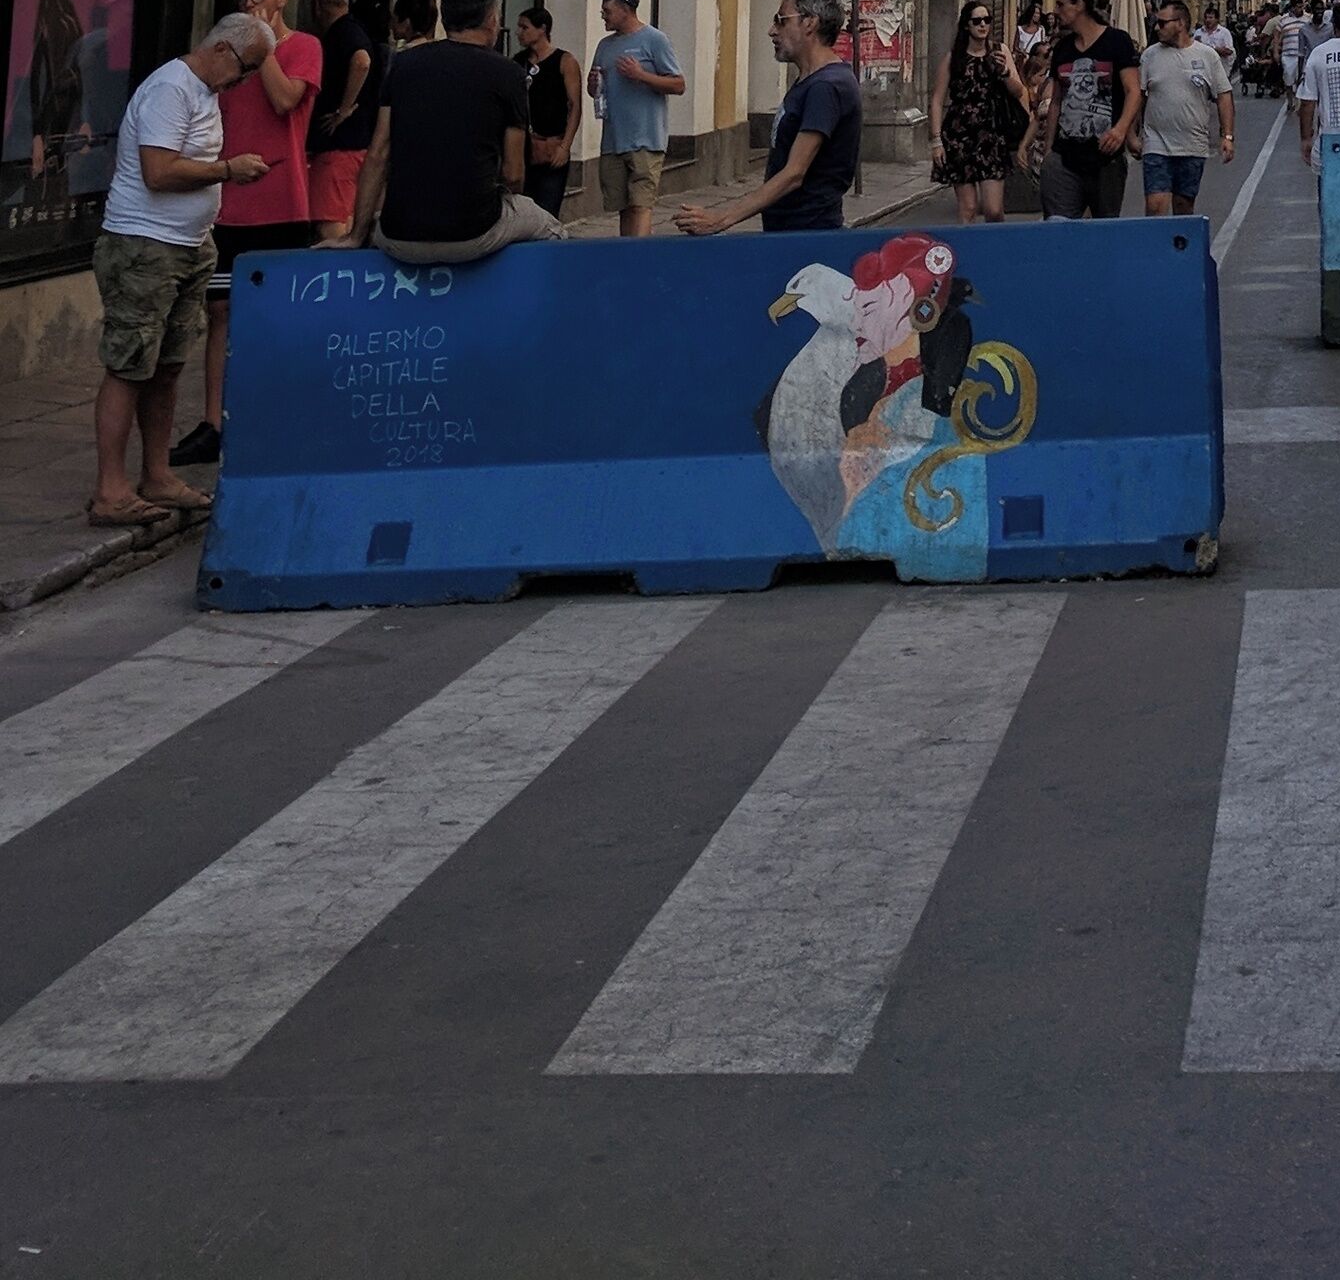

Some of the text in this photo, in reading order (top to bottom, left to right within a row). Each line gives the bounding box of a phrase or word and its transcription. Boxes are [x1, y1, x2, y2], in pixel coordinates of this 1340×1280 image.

[327, 326, 446, 359] PALERMO
[333, 357, 449, 391] CAPITALE
[351, 392, 441, 419] DELLA
[368, 419, 478, 444] CULTURA
[386, 445, 445, 467] 2018
